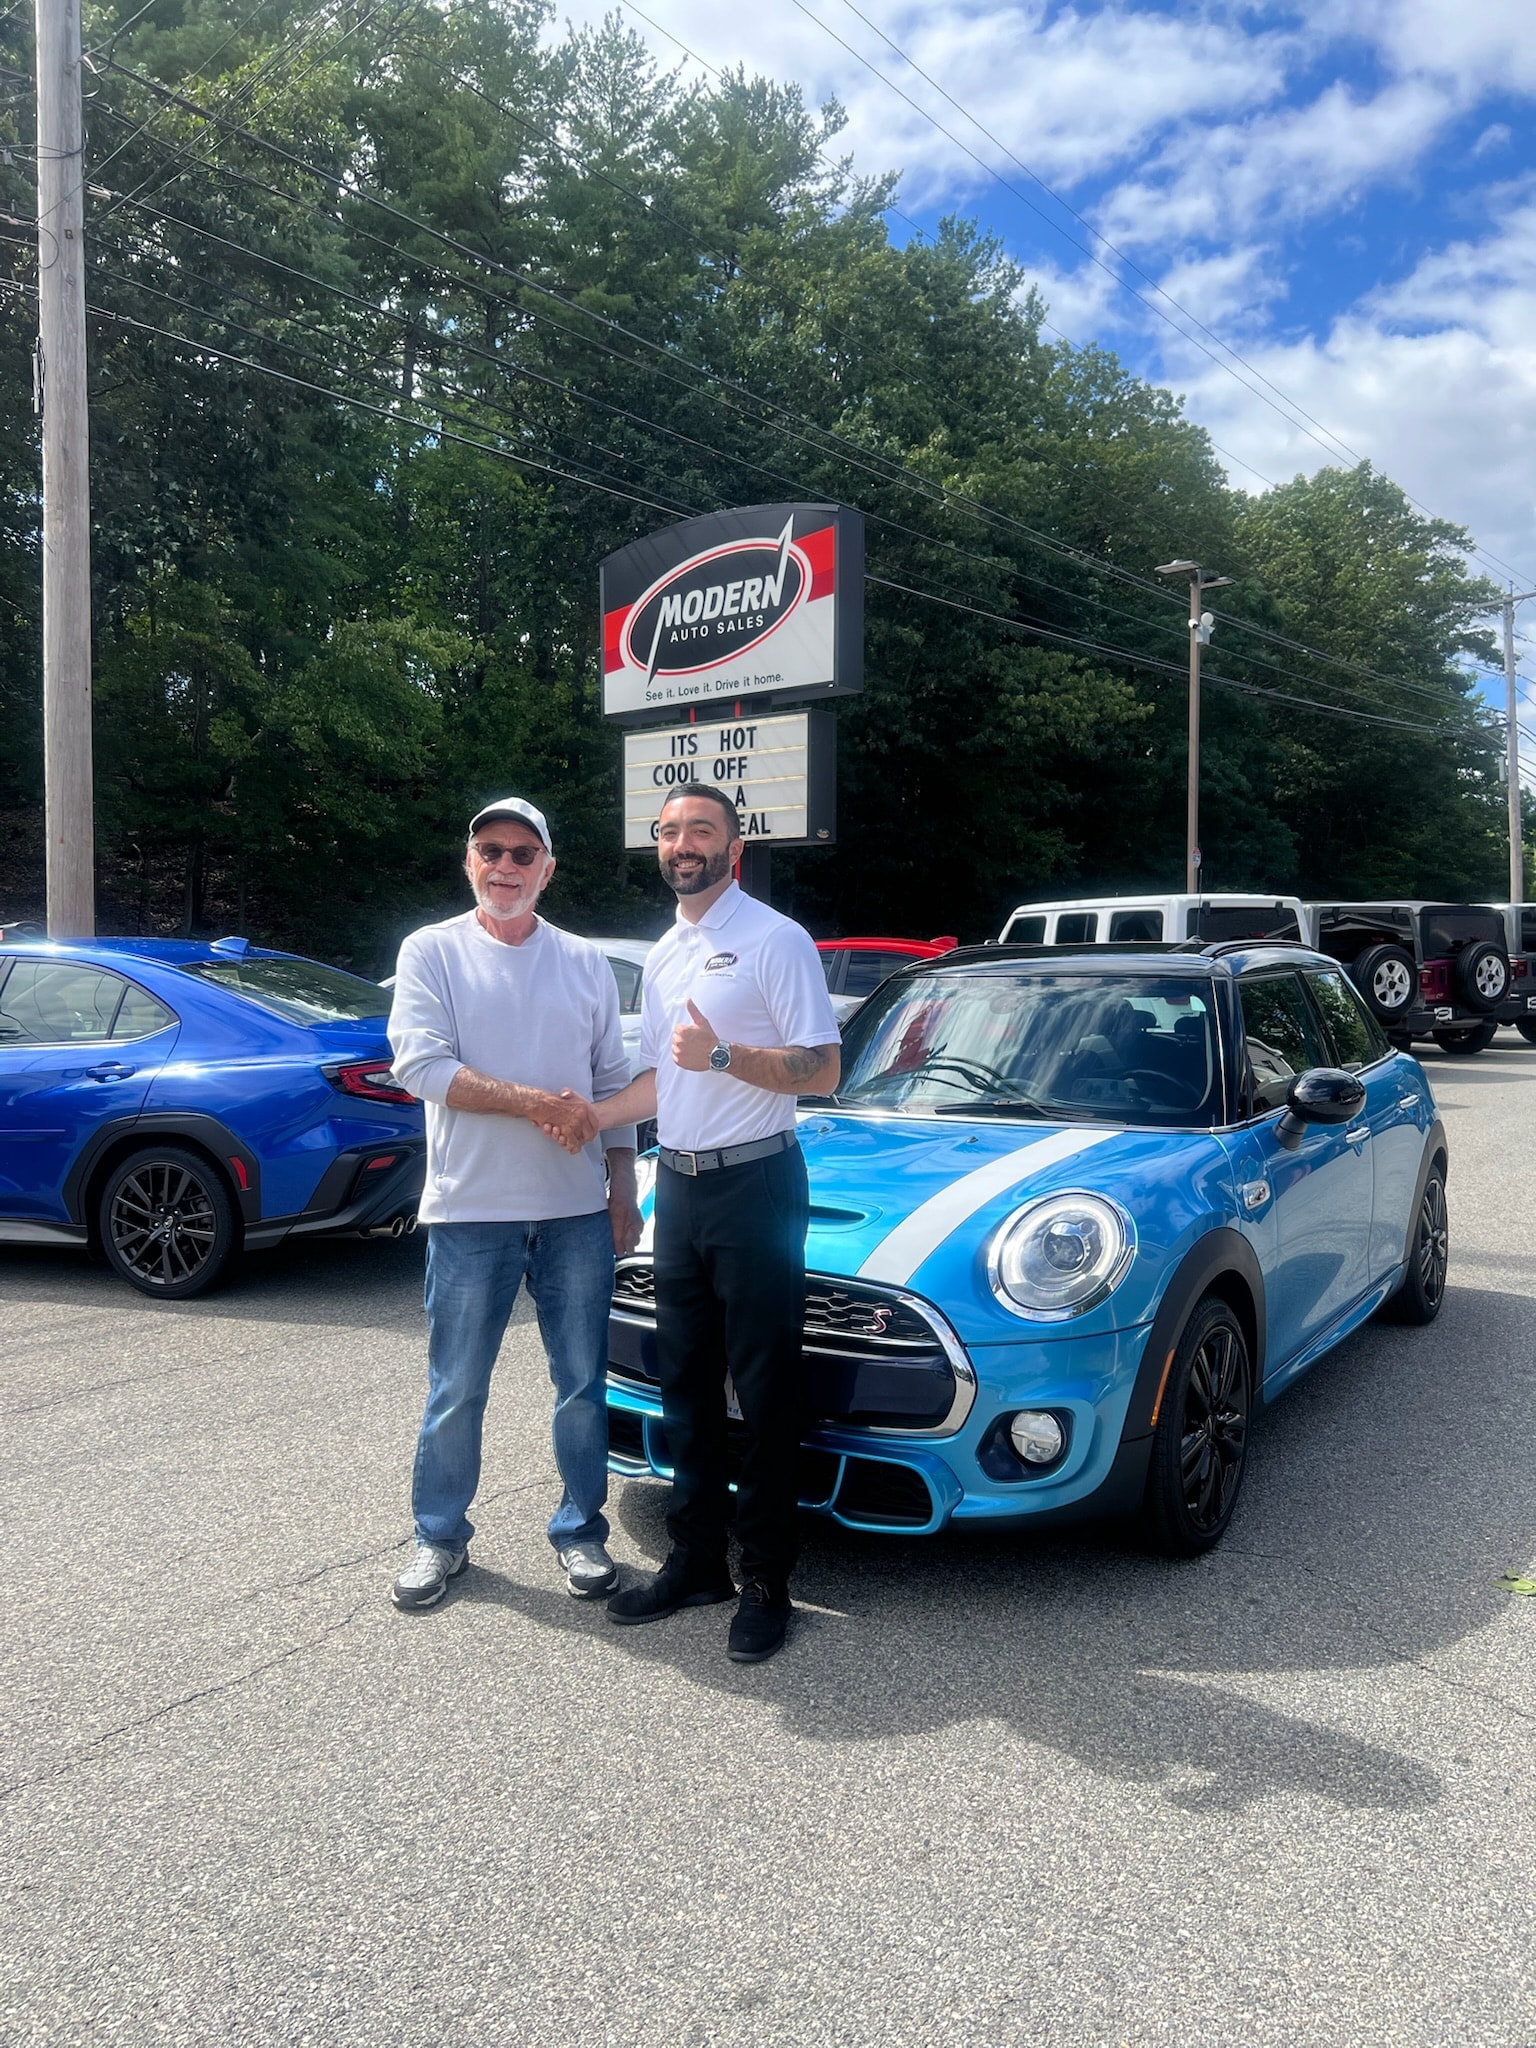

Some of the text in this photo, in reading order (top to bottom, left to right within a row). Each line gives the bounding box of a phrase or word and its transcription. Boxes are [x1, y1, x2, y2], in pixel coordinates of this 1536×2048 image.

[657, 573, 787, 628] MODERN
[670, 614, 764, 643] AUTO SALES
[645, 673, 784, 701] See it. Love it. Drive it home.
[671, 726, 757, 757] ITS HOT
[653, 756, 747, 786] COOL OFF
[735, 785, 746, 807] A
[863, 1308, 893, 1334] S
